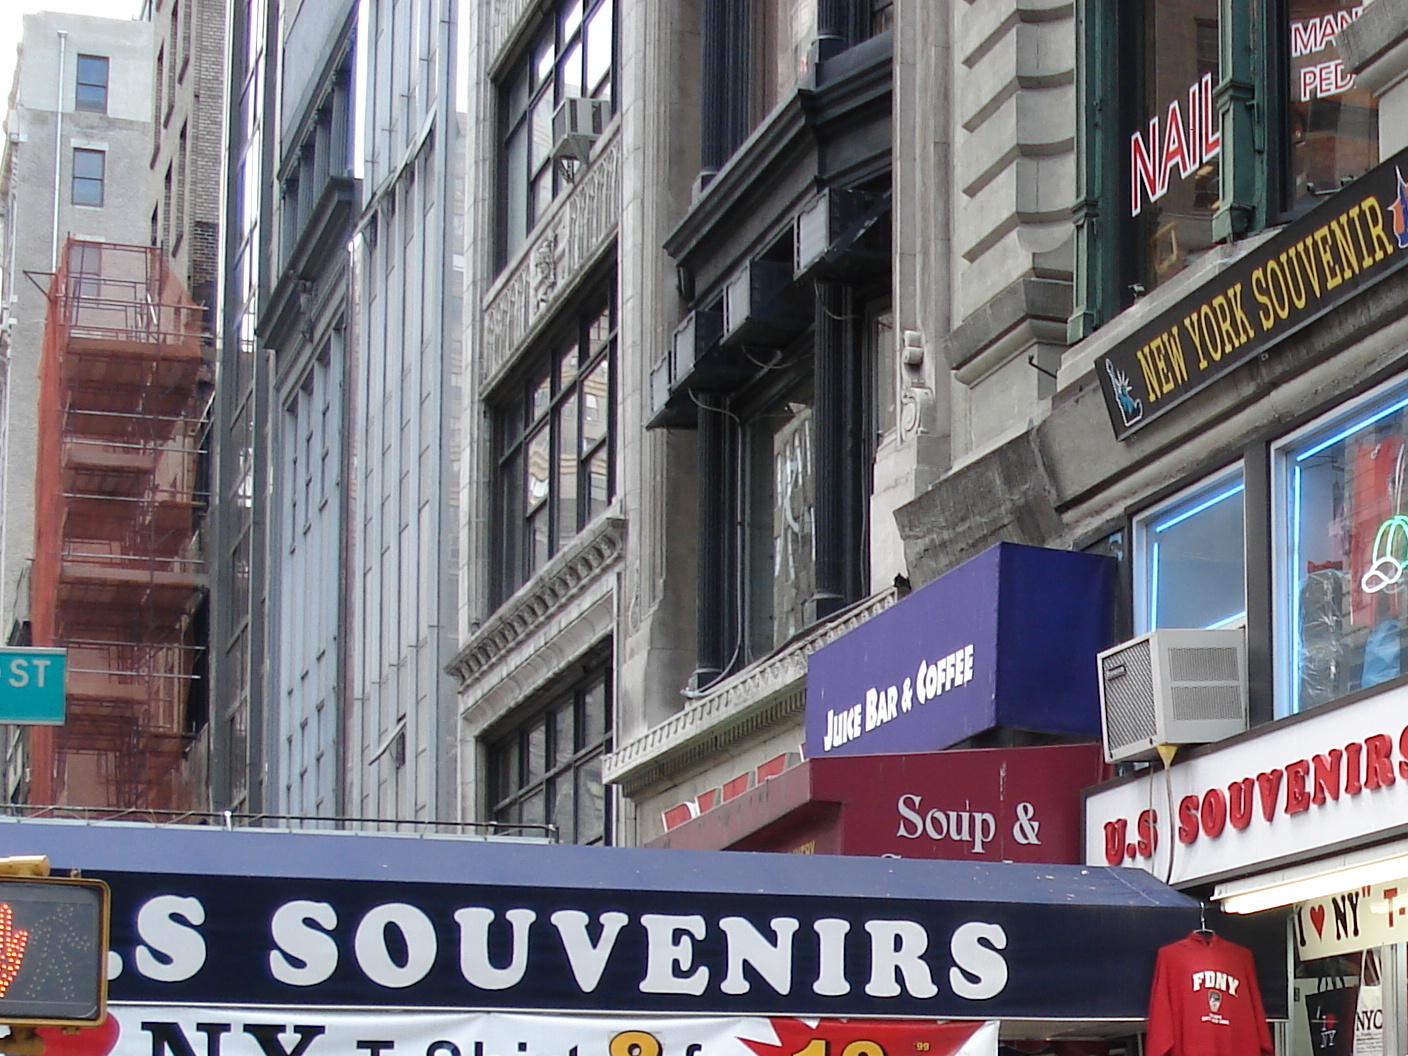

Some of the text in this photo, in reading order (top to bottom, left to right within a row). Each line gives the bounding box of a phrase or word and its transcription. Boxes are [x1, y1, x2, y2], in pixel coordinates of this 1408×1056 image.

[1136, 194, 1393, 403] NEW YORK SOUVENIR
[9, 659, 51, 688] ST
[901, 677, 913, 713] &
[896, 794, 1042, 854] Soup &
[1103, 808, 1158, 867] U.S
[268, 899, 1009, 1000] SOUVENIRS
[1192, 970, 1240, 997] FDNY
